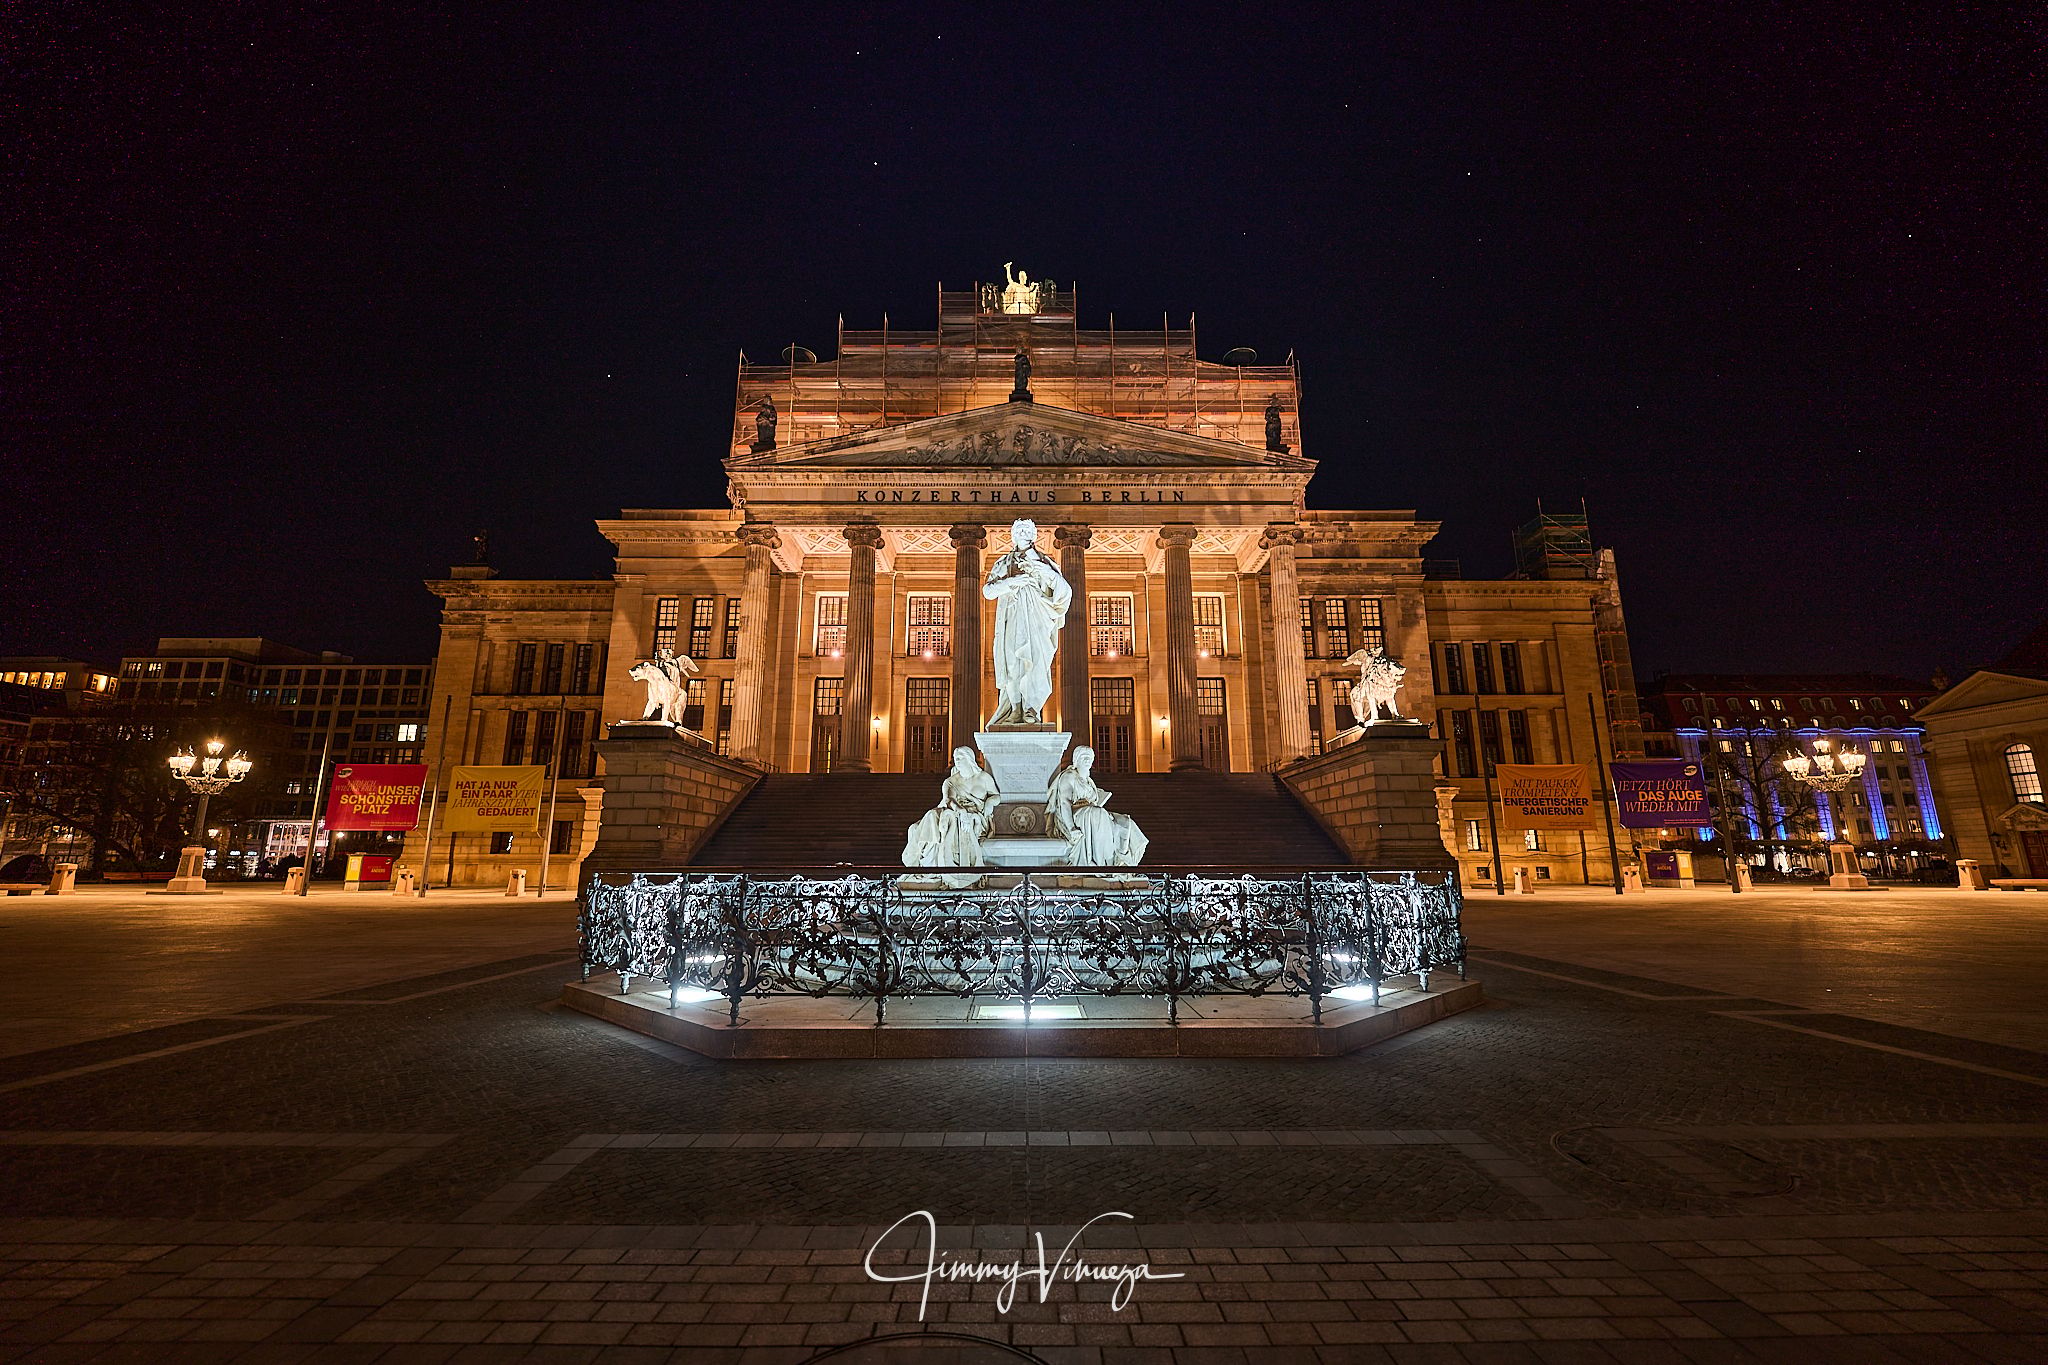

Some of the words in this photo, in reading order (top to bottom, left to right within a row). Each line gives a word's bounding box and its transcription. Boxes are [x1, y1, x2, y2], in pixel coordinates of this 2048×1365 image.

[857, 490, 1057, 502] KONZERTHAUS
[1081, 490, 1184, 502] BERLIN
[456, 781, 477, 789] HAT
[479, 781, 490, 789] JA
[494, 781, 517, 789] NUR
[1513, 779, 1534, 788] MIT
[1618, 780, 1654, 792] JETZT
[1656, 778, 1691, 790] HÖRT
[378, 786, 421, 795] UNSER
[462, 790, 479, 798] EIN
[483, 790, 512, 798] PAAR
[515, 790, 538, 798] VIER
[1504, 788, 1569, 797] TROMPETEN
[1570, 788, 1579, 797] &
[340, 793, 416, 804] SCHÖNSTER
[1638, 790, 1665, 801] DAS
[1668, 790, 1703, 801] AUGE
[452, 799, 530, 808] JAHRESZEITEN
[1504, 798, 1589, 806] ENERGETISCHER
[1625, 801, 1674, 812] WIEDER
[1676, 801, 1701, 812] MIT
[353, 804, 390, 814] PLATZ
[478, 808, 536, 816] GEDAUERT
[1522, 807, 1584, 815] SANIERUNG
